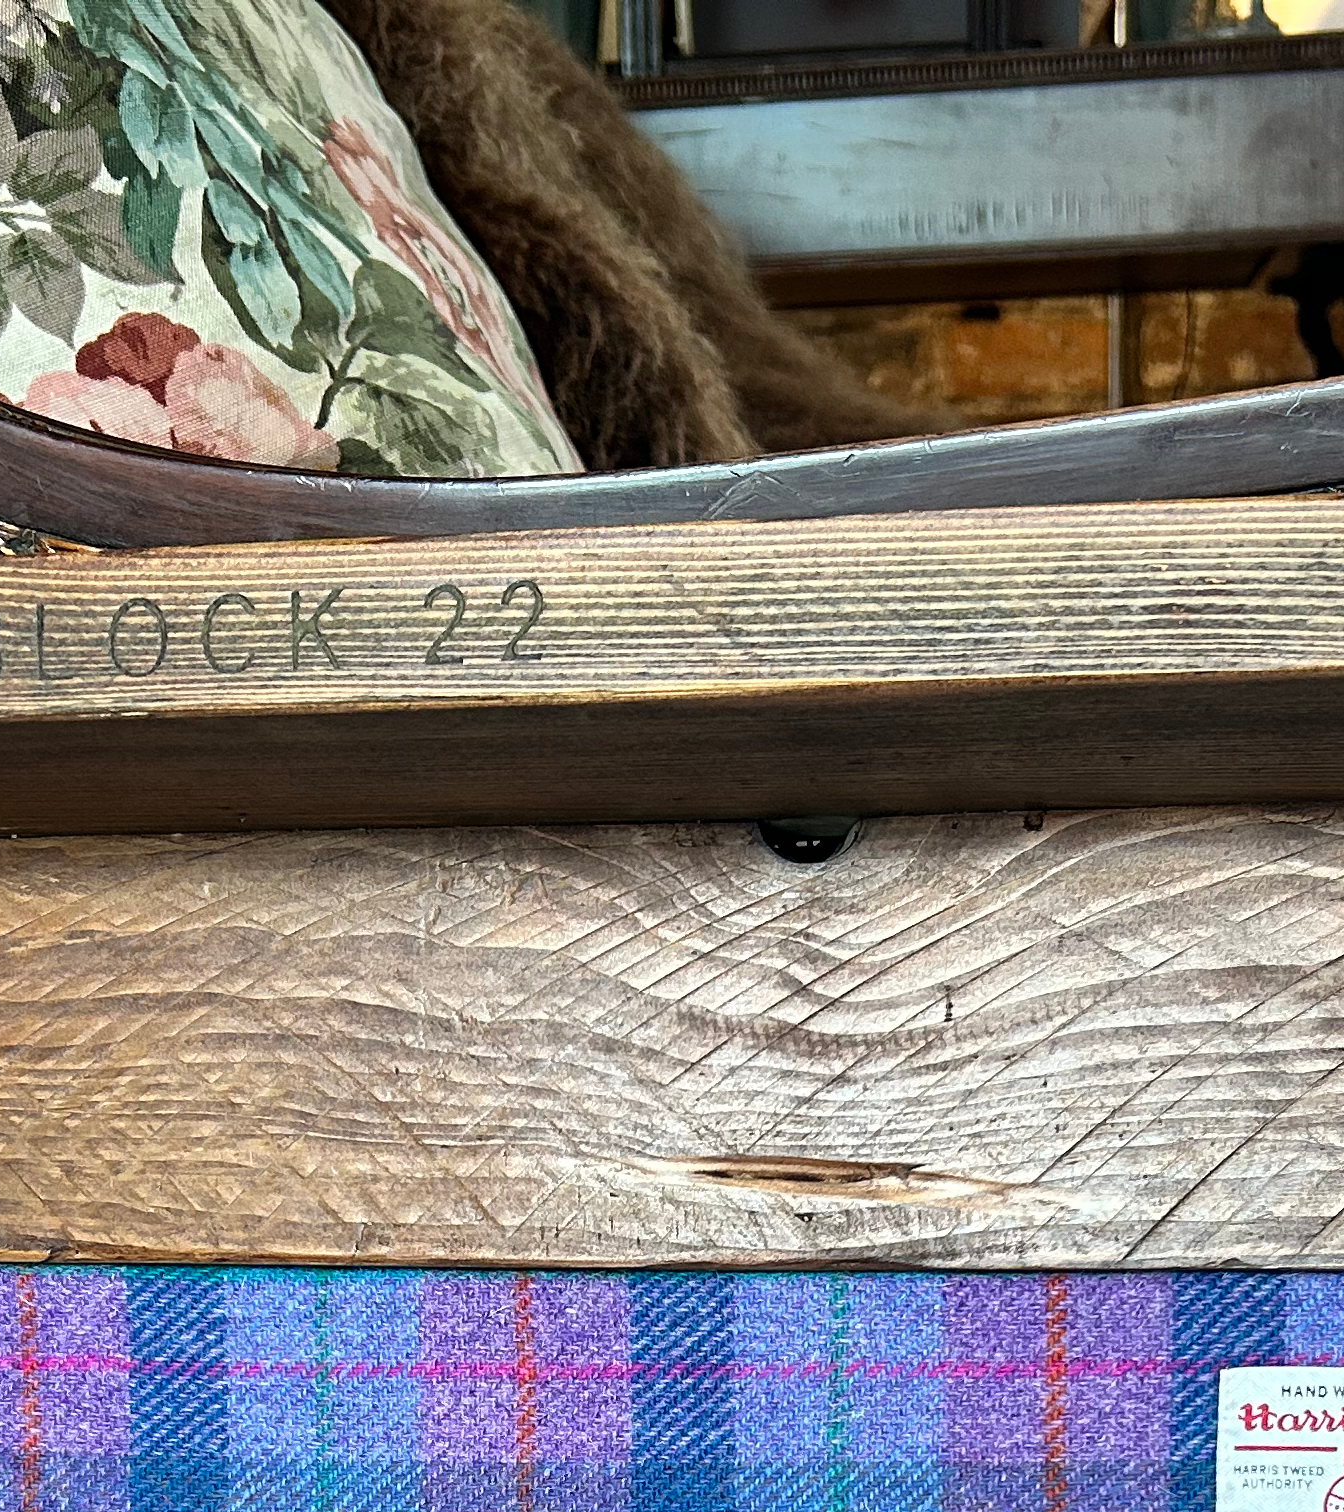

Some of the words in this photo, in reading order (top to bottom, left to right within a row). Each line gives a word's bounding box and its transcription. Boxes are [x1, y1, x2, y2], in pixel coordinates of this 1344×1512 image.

[423, 580, 544, 665] 22
[1281, 1385, 1328, 1398] HAND
[1233, 1465, 1279, 1476] HARRIS
[1283, 1466, 1325, 1477] TWEED
[1242, 1479, 1314, 1490] AUTHORITY
